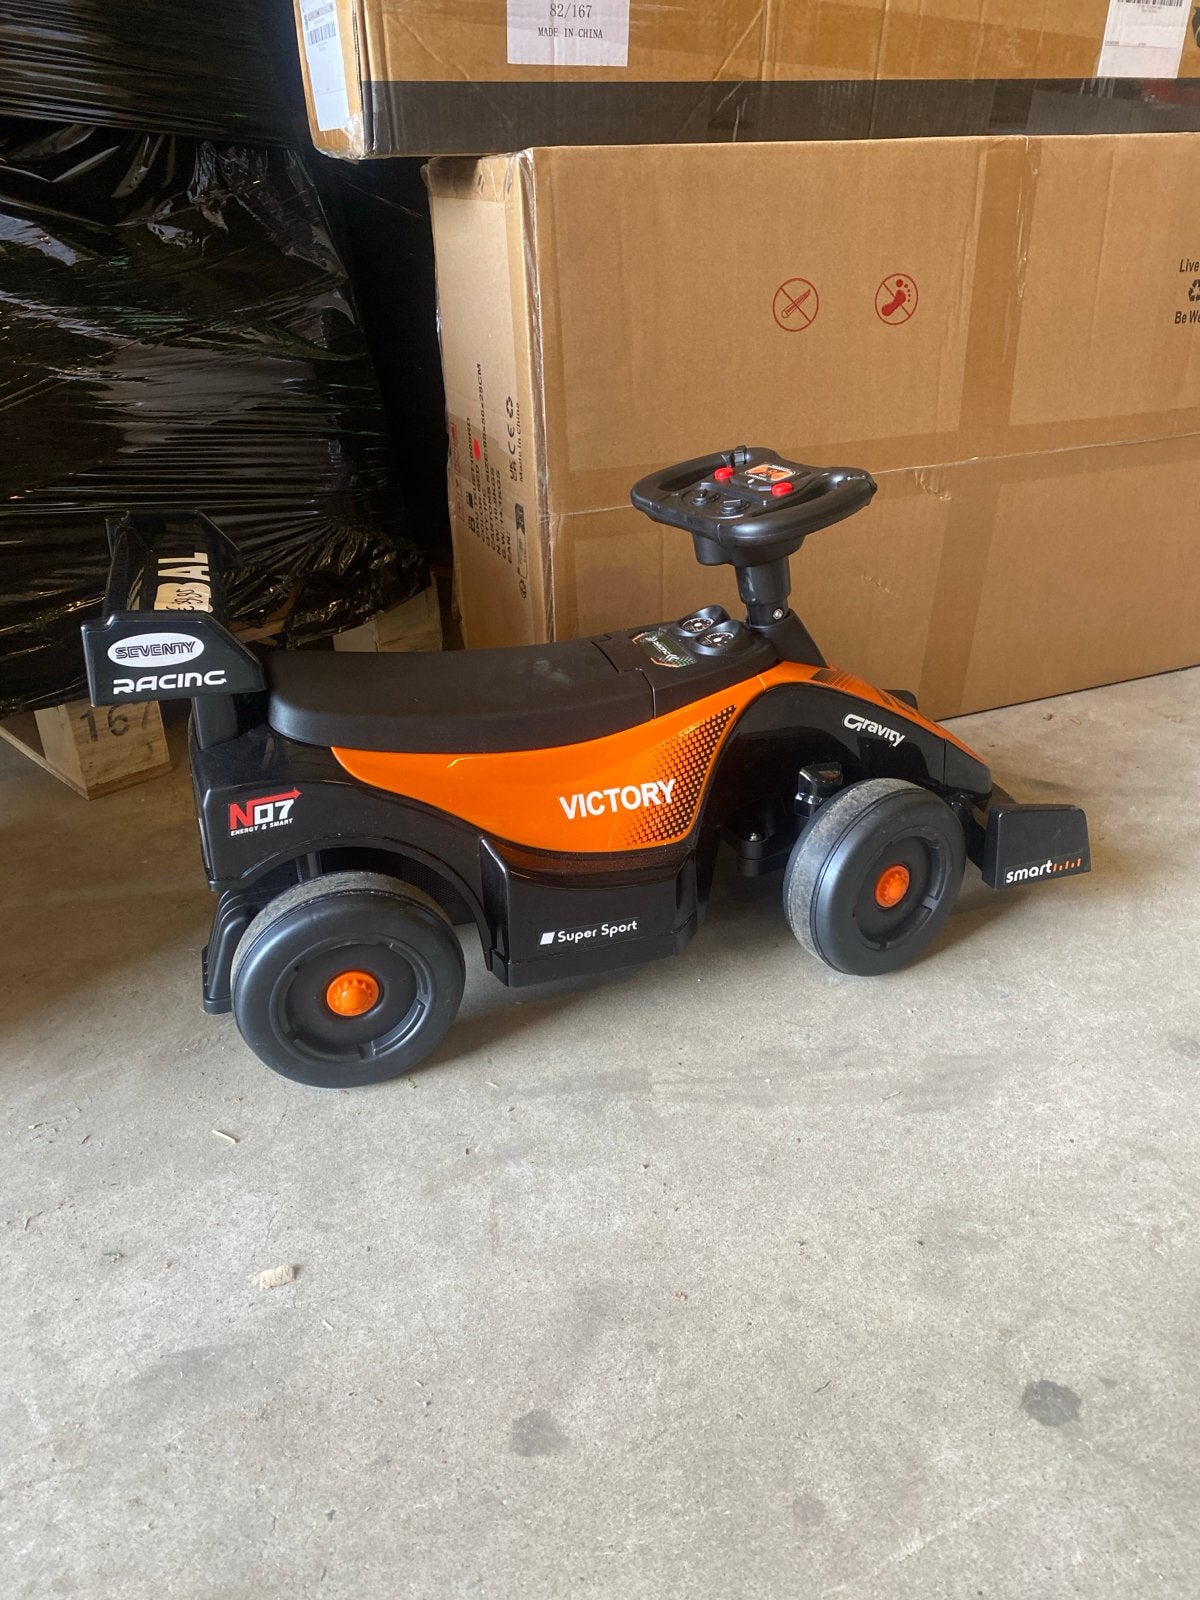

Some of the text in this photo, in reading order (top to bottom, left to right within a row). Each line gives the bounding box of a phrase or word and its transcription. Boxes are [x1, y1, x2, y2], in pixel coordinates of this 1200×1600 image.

[549, 2, 593, 18] 82/167
[537, 26, 603, 39] MADE IN CHINA
[1179, 259, 1200, 273] Live
[1174, 310, 1188, 325] Be
[115, 641, 196, 659] SEVENTY
[113, 669, 227, 694] RACING
[843, 713, 906, 748] Gravity
[558, 778, 677, 820] VICTORY
[230, 817, 293, 836] ENERGY & SMART
[1005, 859, 1053, 883] smart
[557, 919, 638, 943] Super Sport
